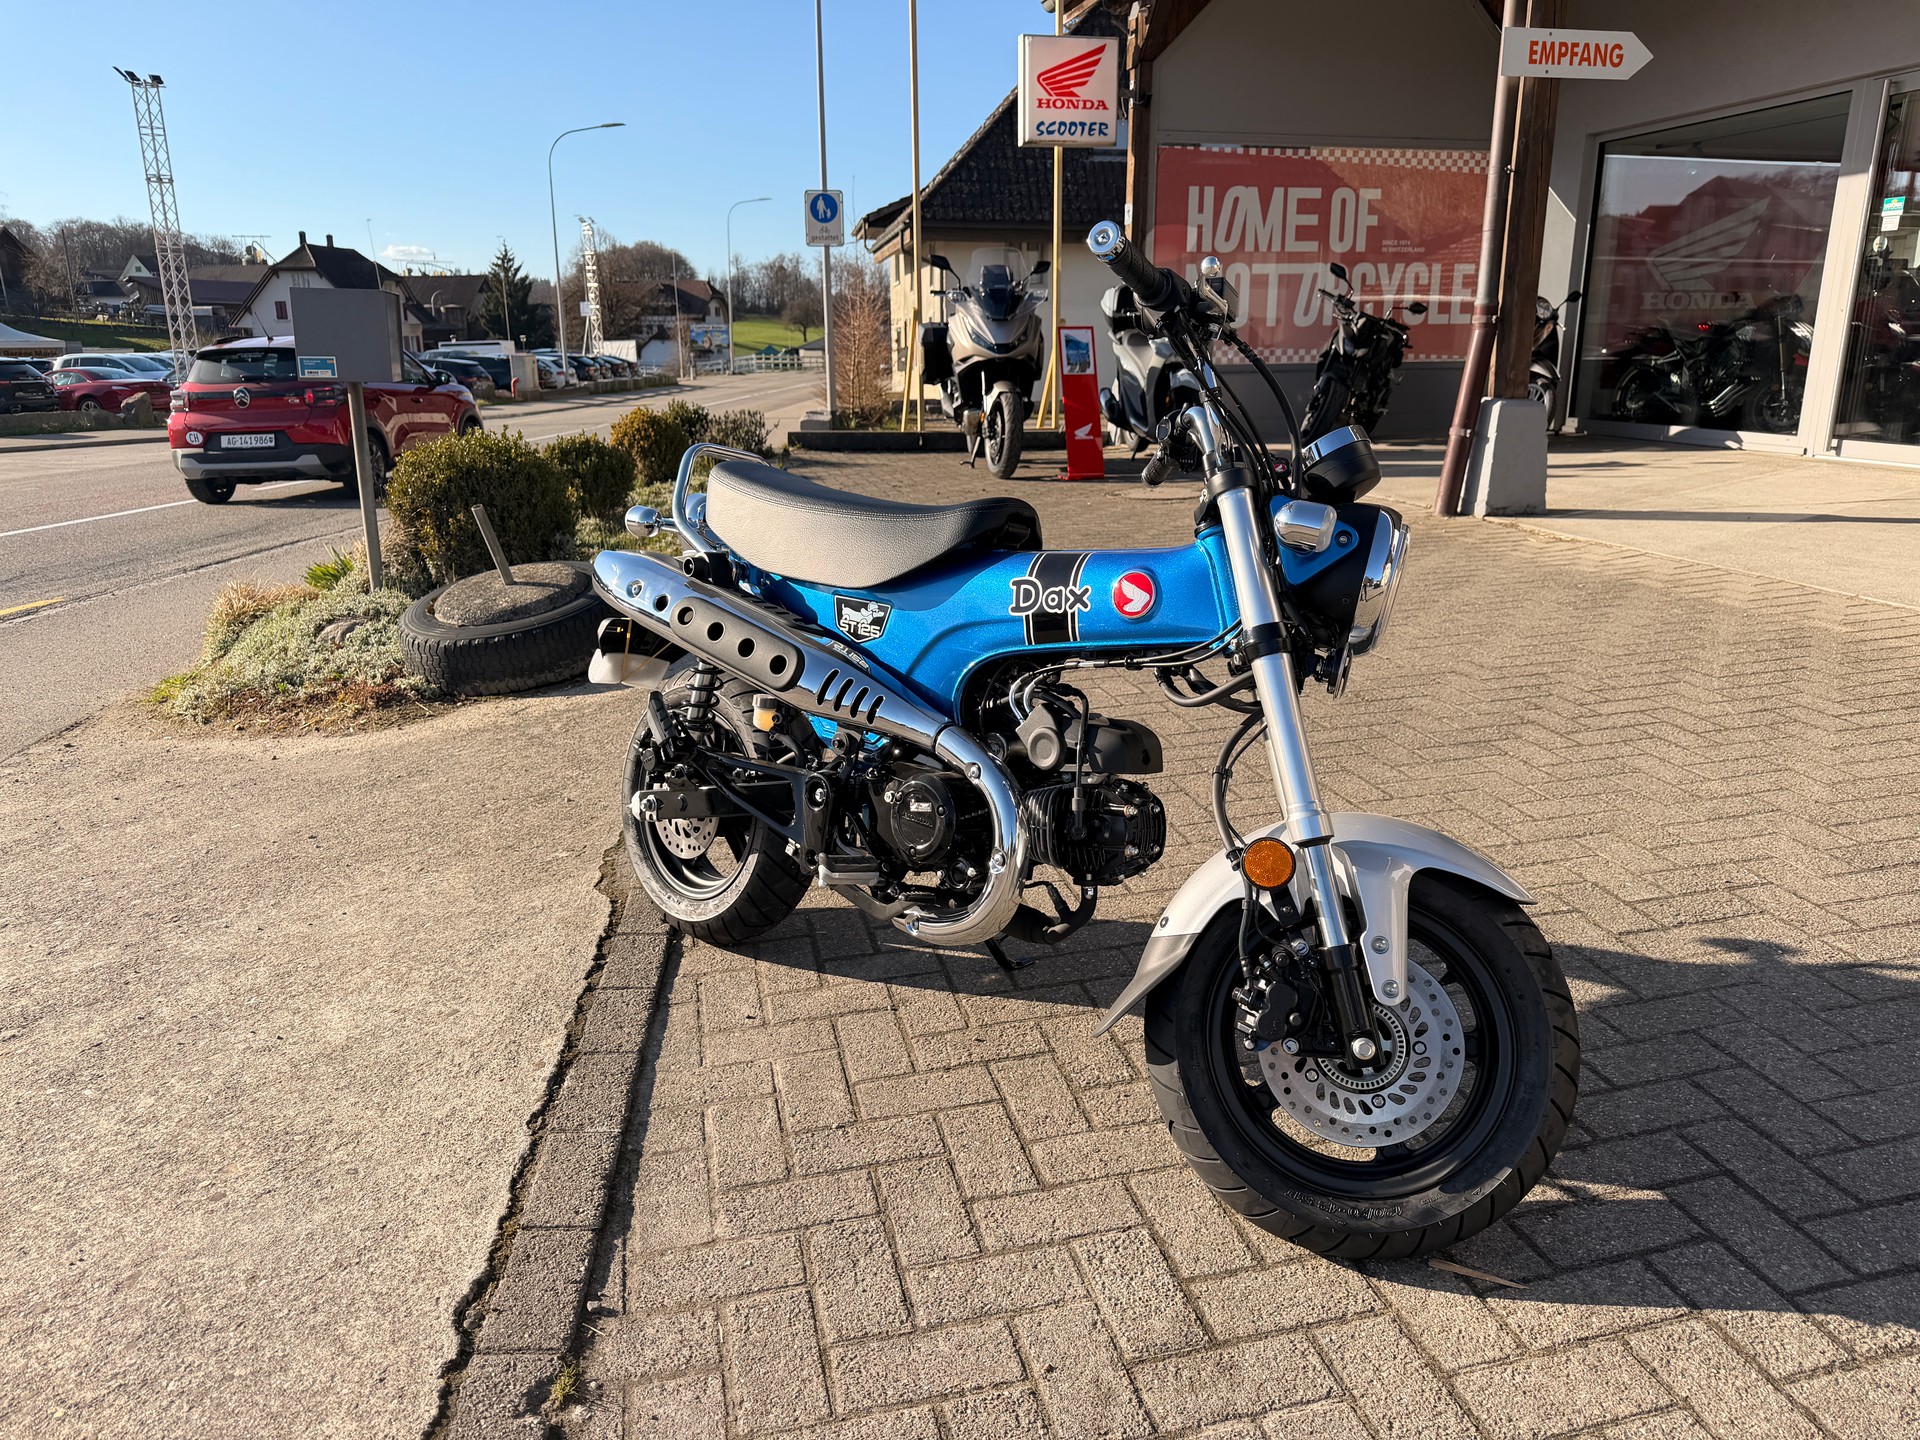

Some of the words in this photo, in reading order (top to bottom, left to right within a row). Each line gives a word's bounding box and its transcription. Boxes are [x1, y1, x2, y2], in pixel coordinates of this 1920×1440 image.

[1528, 40, 1624, 68] EMPFANG
[1036, 98, 1109, 111] HONDA
[1036, 121, 1108, 137] SCOOTER
[1329, 187, 1382, 253] OF
[1640, 291, 1758, 310] HONDA
[188, 432, 200, 444] CH
[1008, 576, 1092, 616] Dax
[839, 618, 881, 638] ST125
